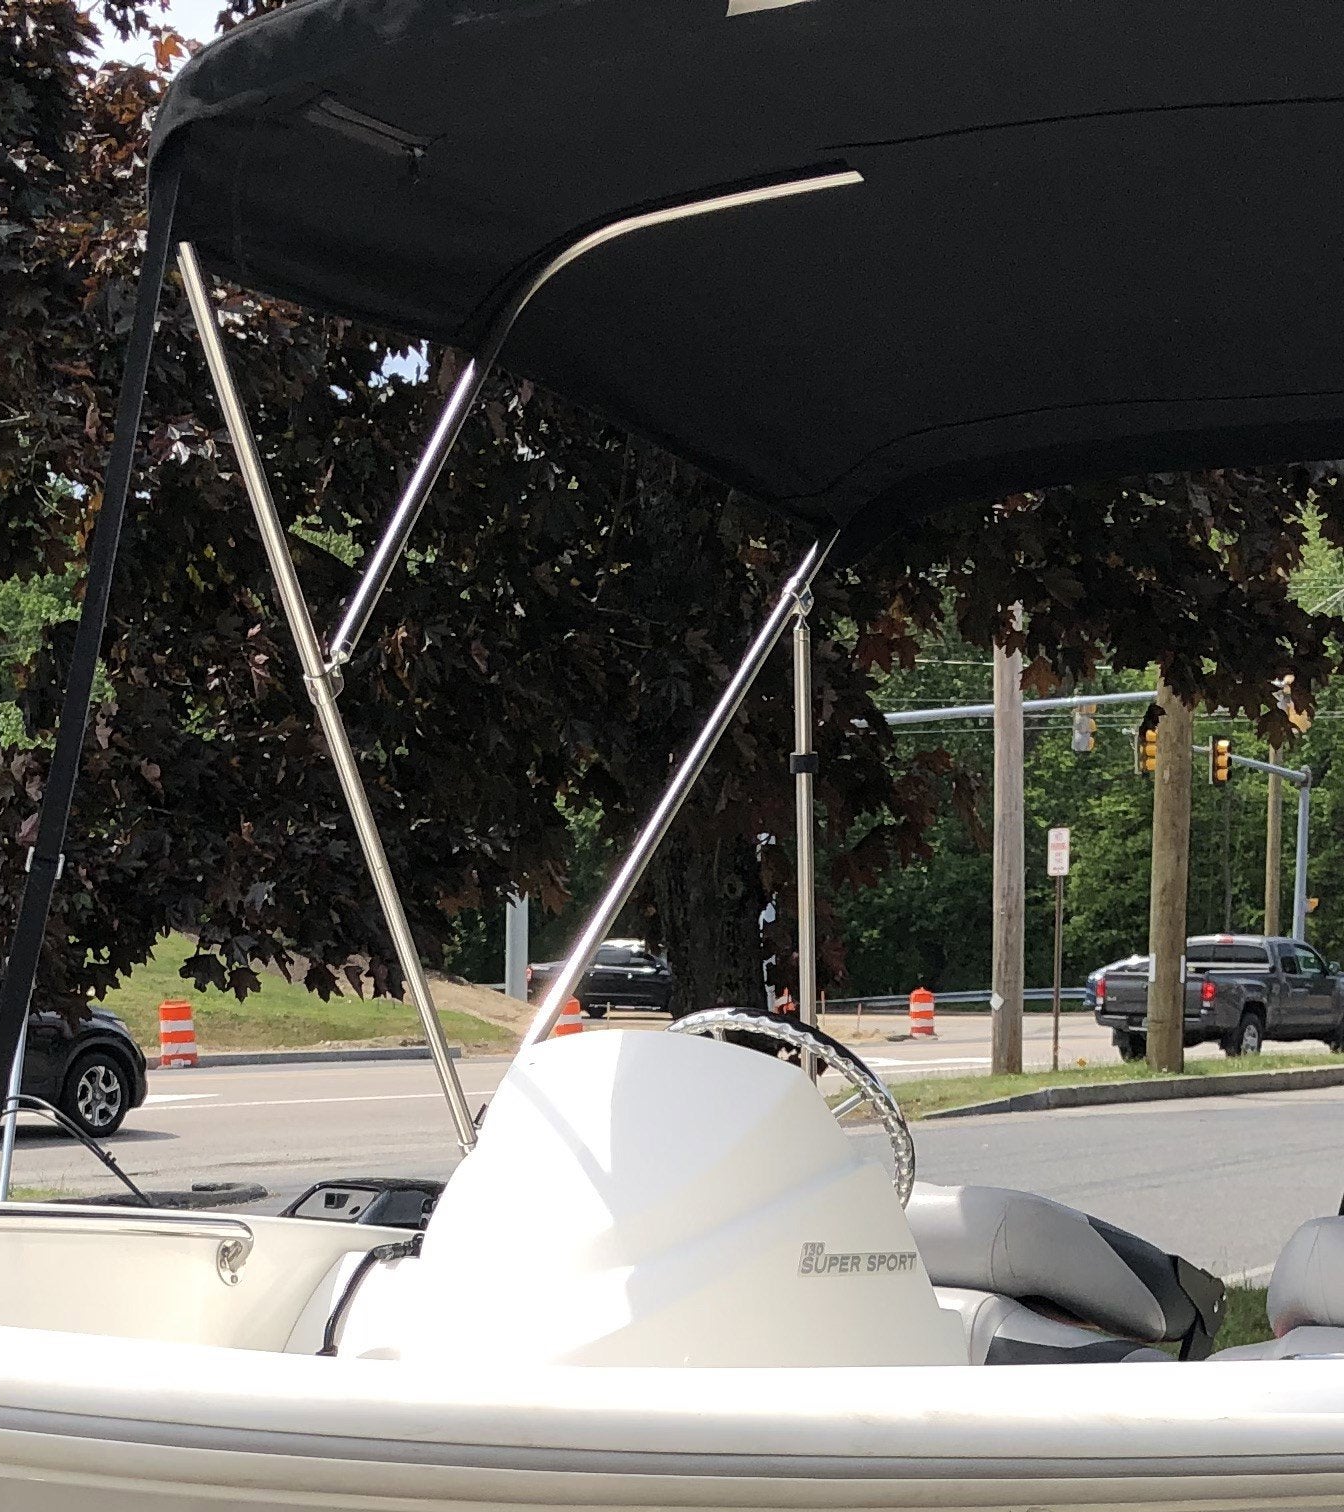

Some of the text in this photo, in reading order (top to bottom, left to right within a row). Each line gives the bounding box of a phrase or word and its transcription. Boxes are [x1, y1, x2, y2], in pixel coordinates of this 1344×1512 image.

[803, 1243, 825, 1256] 130
[800, 1254, 917, 1274] SUPER SPORT
